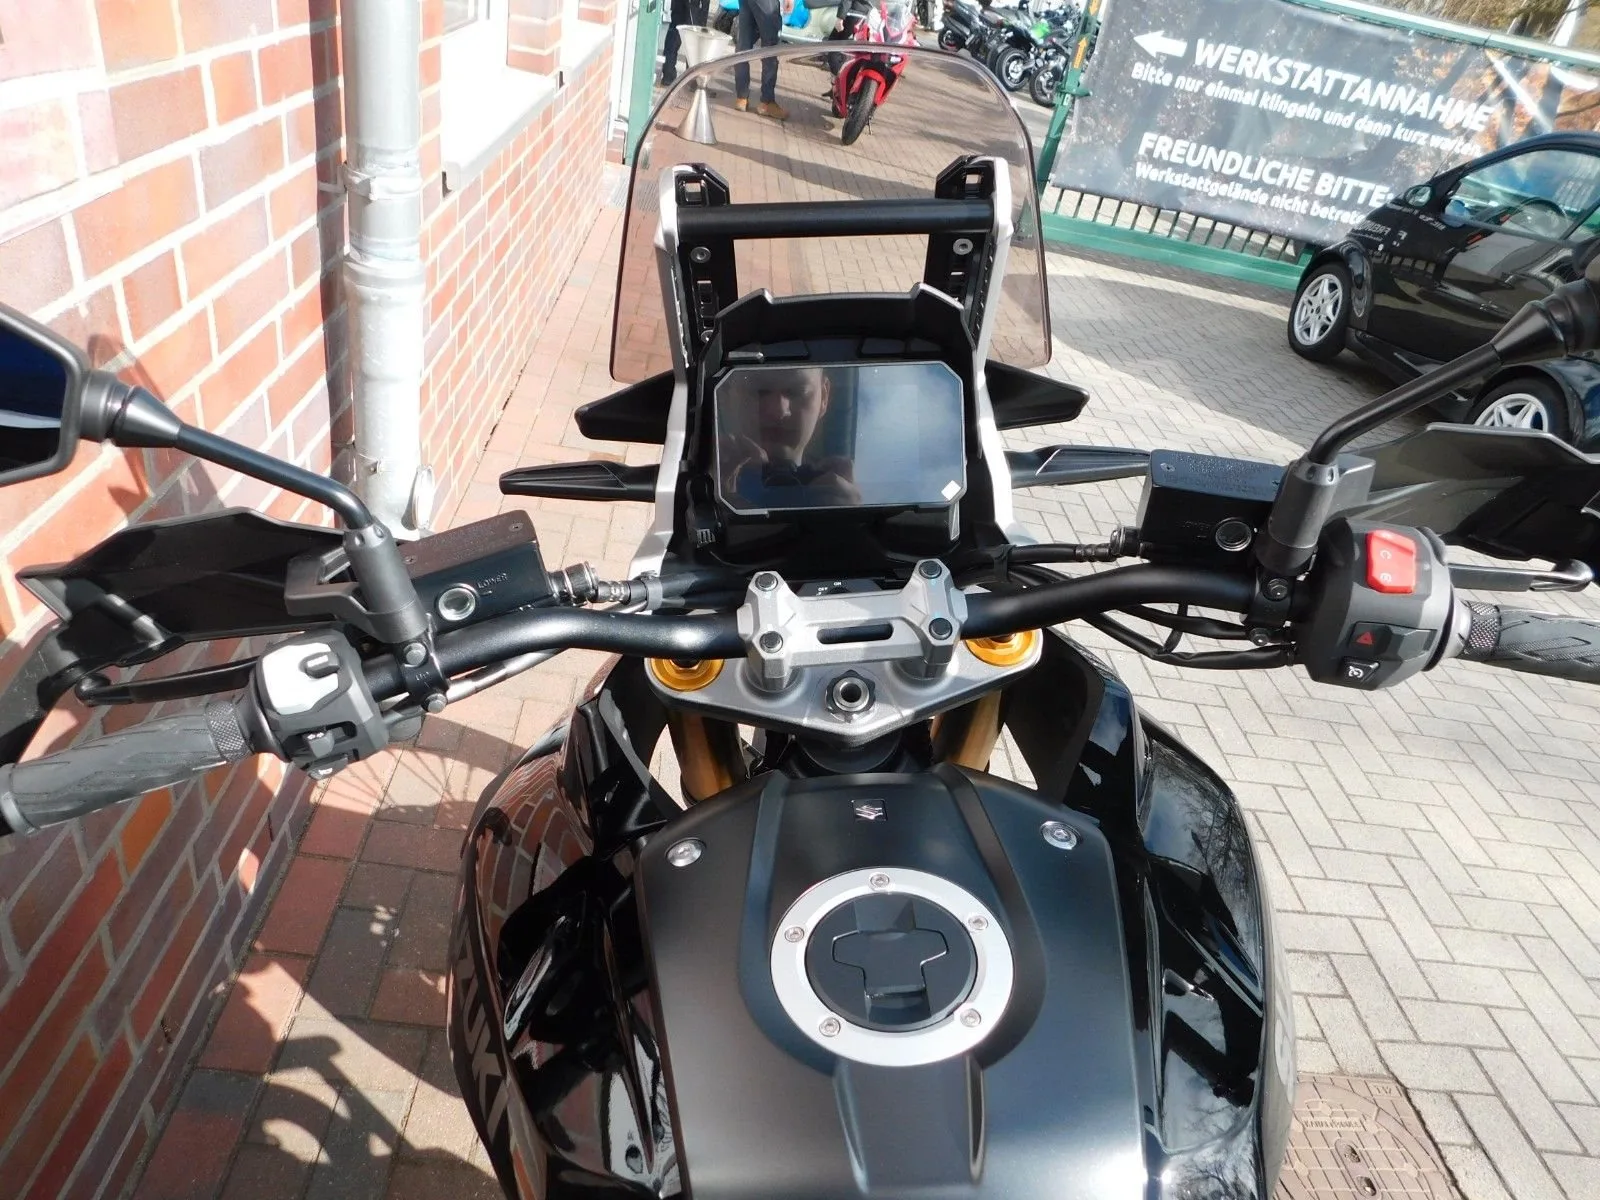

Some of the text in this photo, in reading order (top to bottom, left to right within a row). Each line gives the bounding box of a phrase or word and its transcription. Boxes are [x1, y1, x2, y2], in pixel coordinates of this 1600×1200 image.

[1131, 61, 1173, 87] Bitte
[1174, 75, 1204, 92] nur
[1205, 80, 1259, 107] einmal
[1259, 91, 1321, 121] klingeln
[1323, 110, 1355, 129] und
[1355, 115, 1392, 137] dann
[1392, 123, 1430, 146] kurz
[1195, 38, 1495, 132] WERKSTATTANNAHME
[1135, 161, 1270, 205] Werkstattgelände
[1270, 193, 1309, 215] nicht
[1310, 200, 1366, 225] betrete
[1138, 131, 1315, 193] FREUNDLICHE
